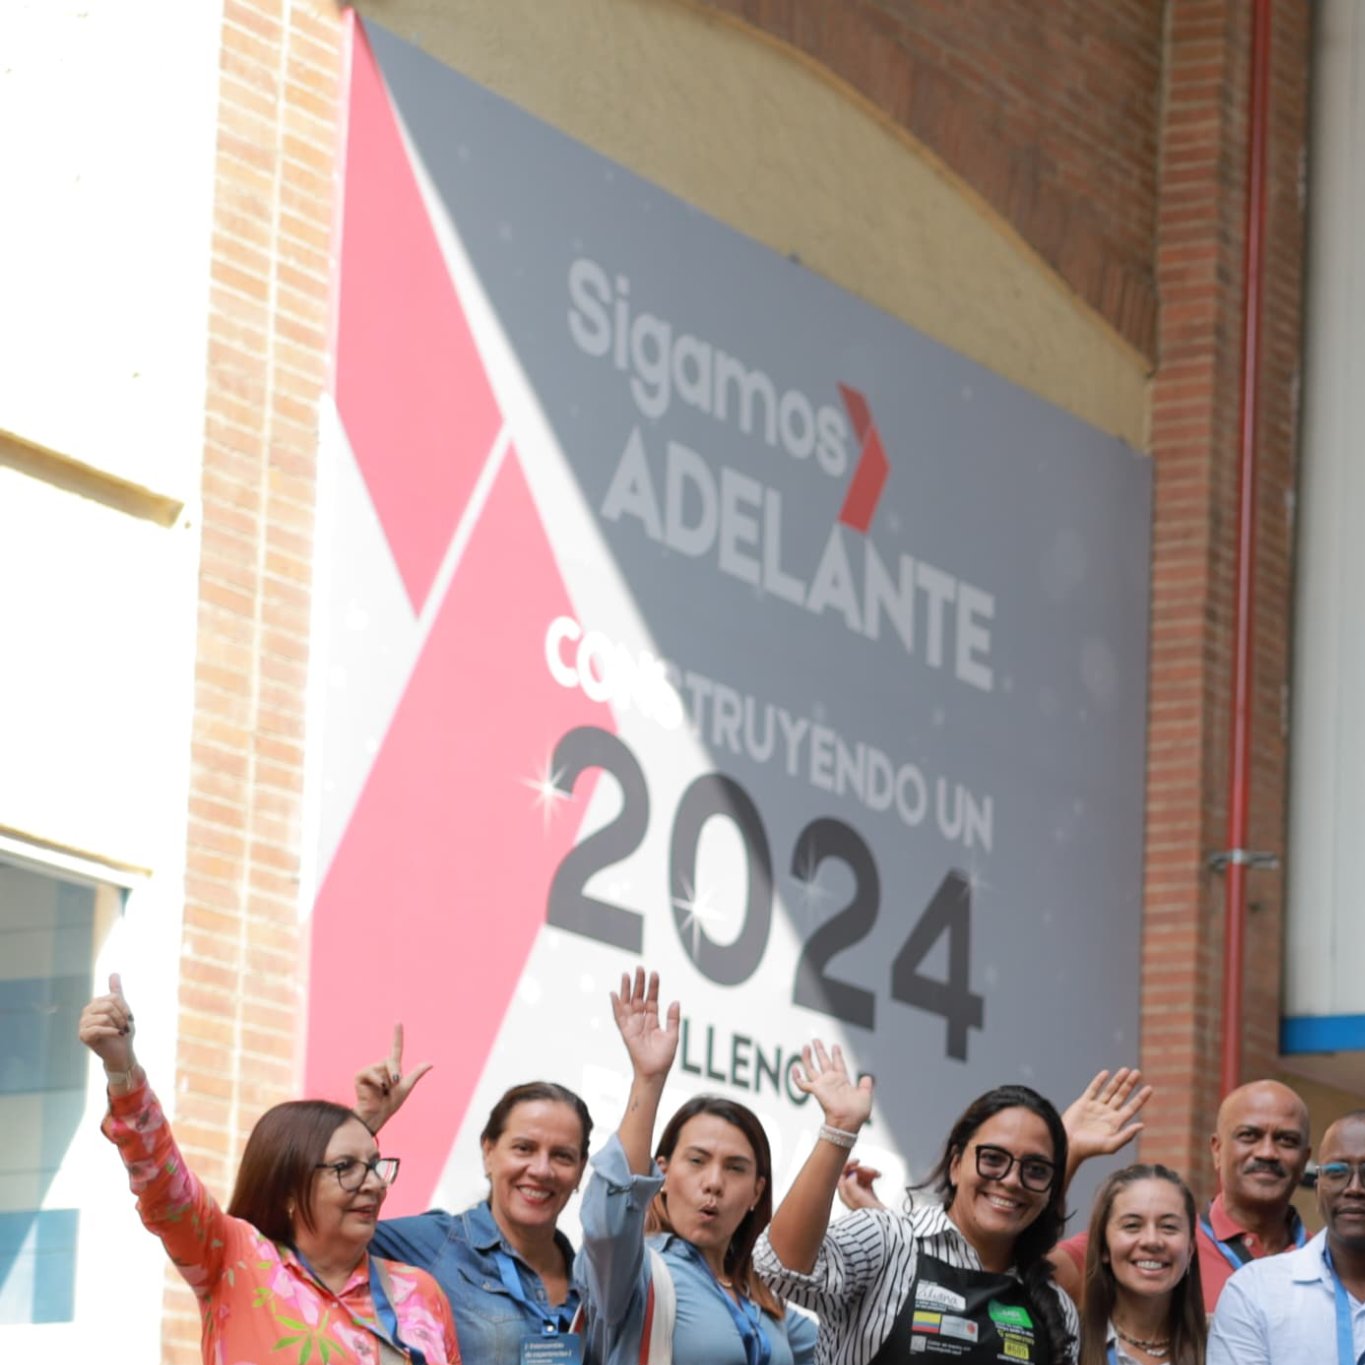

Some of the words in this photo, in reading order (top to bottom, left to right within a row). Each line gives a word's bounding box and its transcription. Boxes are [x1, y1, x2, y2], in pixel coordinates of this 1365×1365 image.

[568, 258, 849, 478] Sigamos
[601, 427, 995, 692] ADELANTE
[545, 615, 927, 824] CONSTRUYENDO
[937, 786, 993, 851] UN
[545, 725, 986, 1062] 2024
